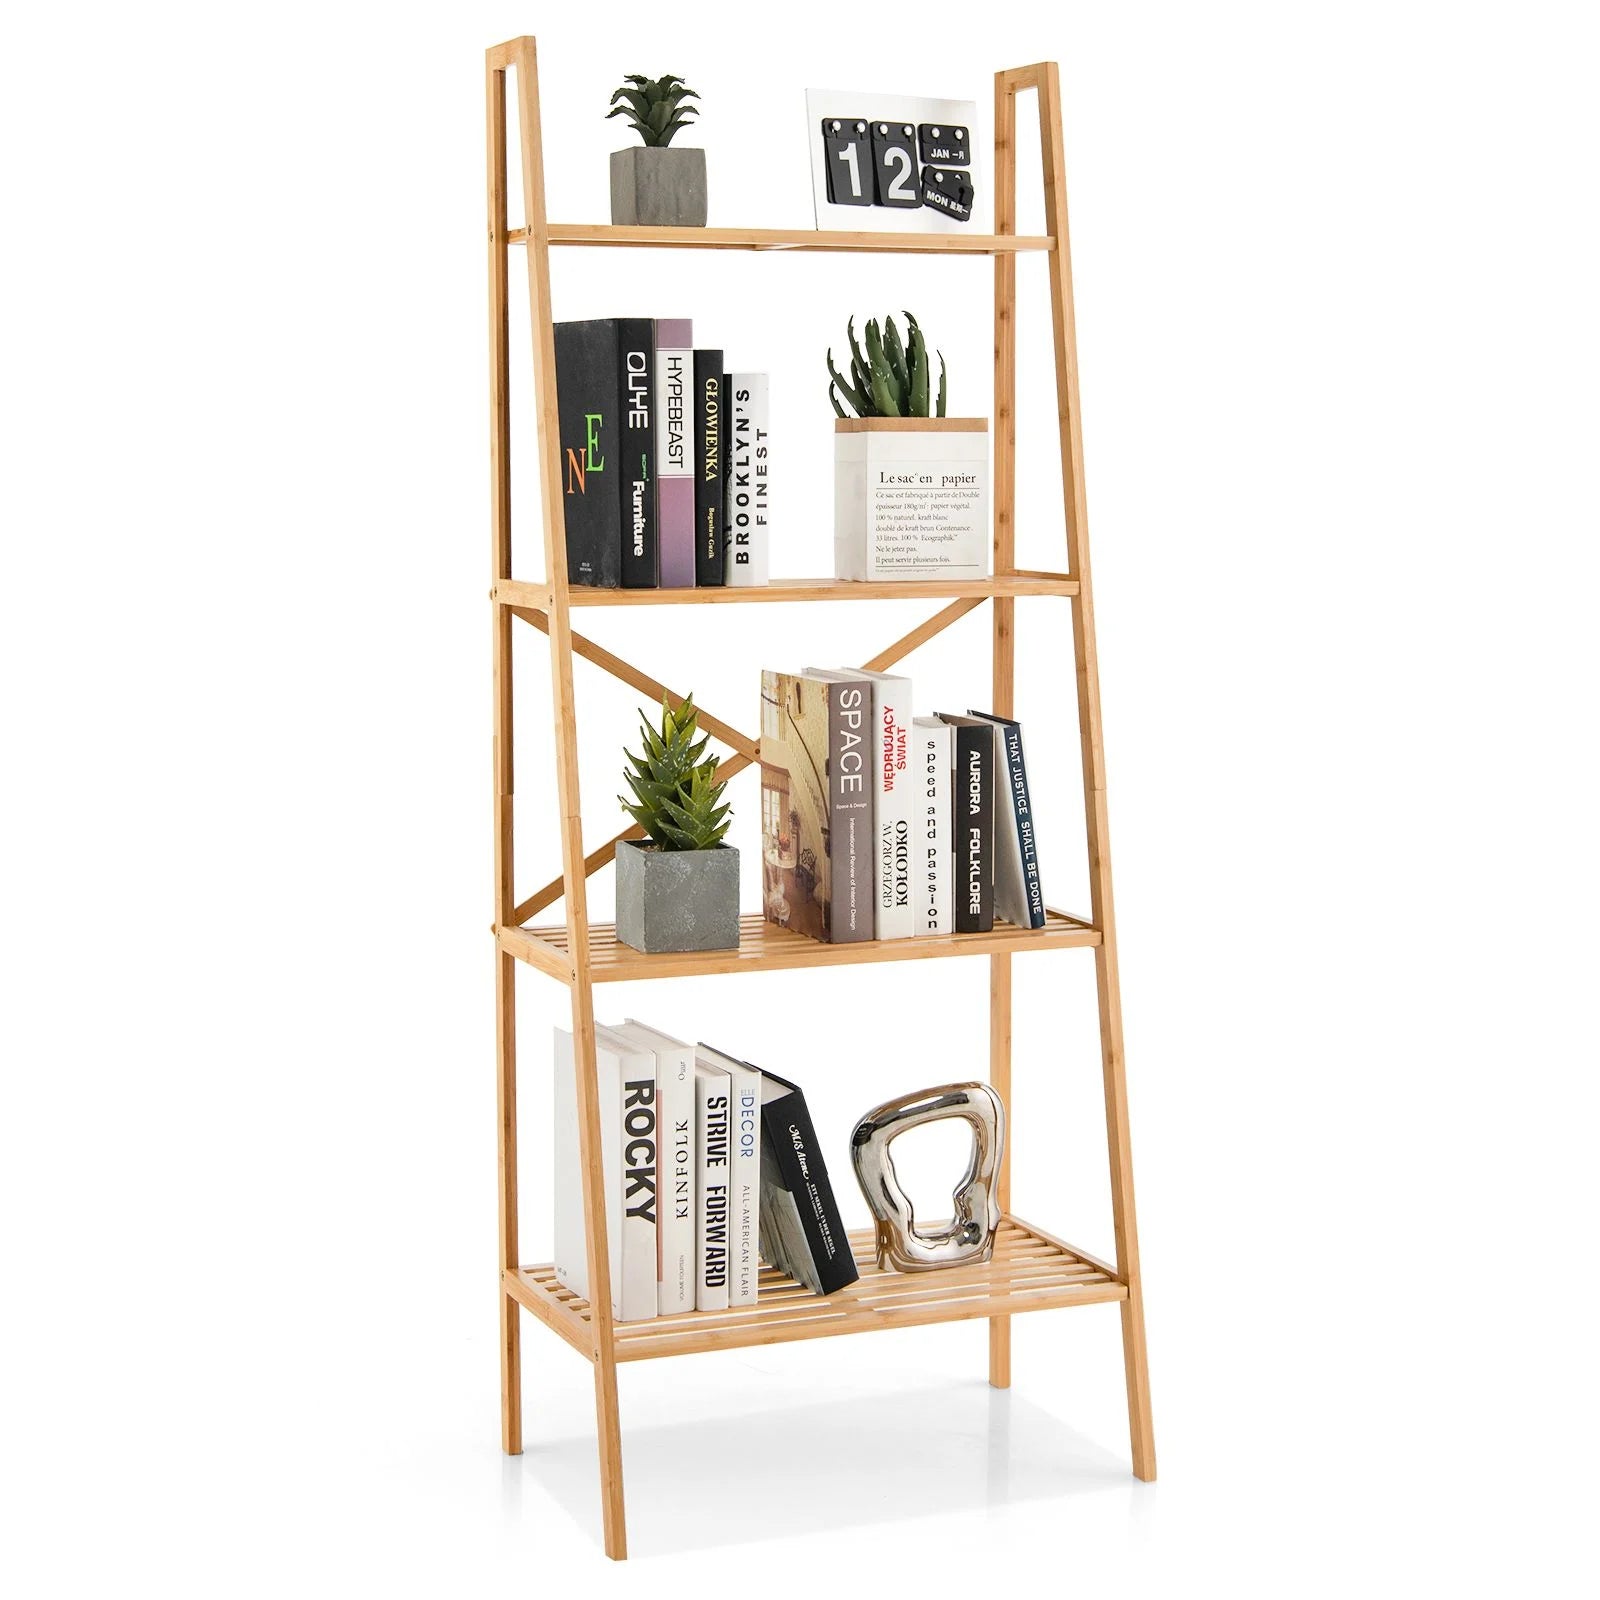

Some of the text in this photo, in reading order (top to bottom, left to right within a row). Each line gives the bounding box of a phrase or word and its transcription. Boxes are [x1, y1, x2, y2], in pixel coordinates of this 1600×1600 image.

[931, 148, 950, 158] JAN
[926, 190, 948, 207] MON
[668, 356, 683, 468] HYPEBEAST
[756, 428, 768, 526] FINEST
[880, 472, 895, 484] Le
[920, 475, 932, 484] en
[941, 472, 976, 486] papier
[930, 503, 949, 511] papier
[934, 492, 950, 500] partir
[958, 490, 980, 499] Double
[632, 480, 645, 556] Furniture
[896, 524, 904, 532] de
[905, 524, 918, 532] kraft
[895, 556, 912, 564] servir
[913, 556, 938, 564] plusieurs
[839, 688, 862, 794] SPACE
[895, 726, 906, 770] ŚWIAT
[854, 802, 867, 810] Design
[926, 741, 937, 928] speed and passion
[969, 750, 980, 915] AURORA FOLKLORE
[1008, 734, 1042, 914] THAT JUSTICE SHALL BE DONE
[882, 838, 892, 908] GRZEGORZ
[896, 820, 908, 906] KOŁODKO
[850, 909, 858, 930] Design
[624, 1079, 656, 1224] ROCKY
[741, 1096, 754, 1158] DECOR
[676, 1120, 689, 1220] KINFOLK
[705, 1096, 727, 1288] STRIVE FORWARD
[741, 1185, 750, 1296] ALL-AMERICAN FLAIR
